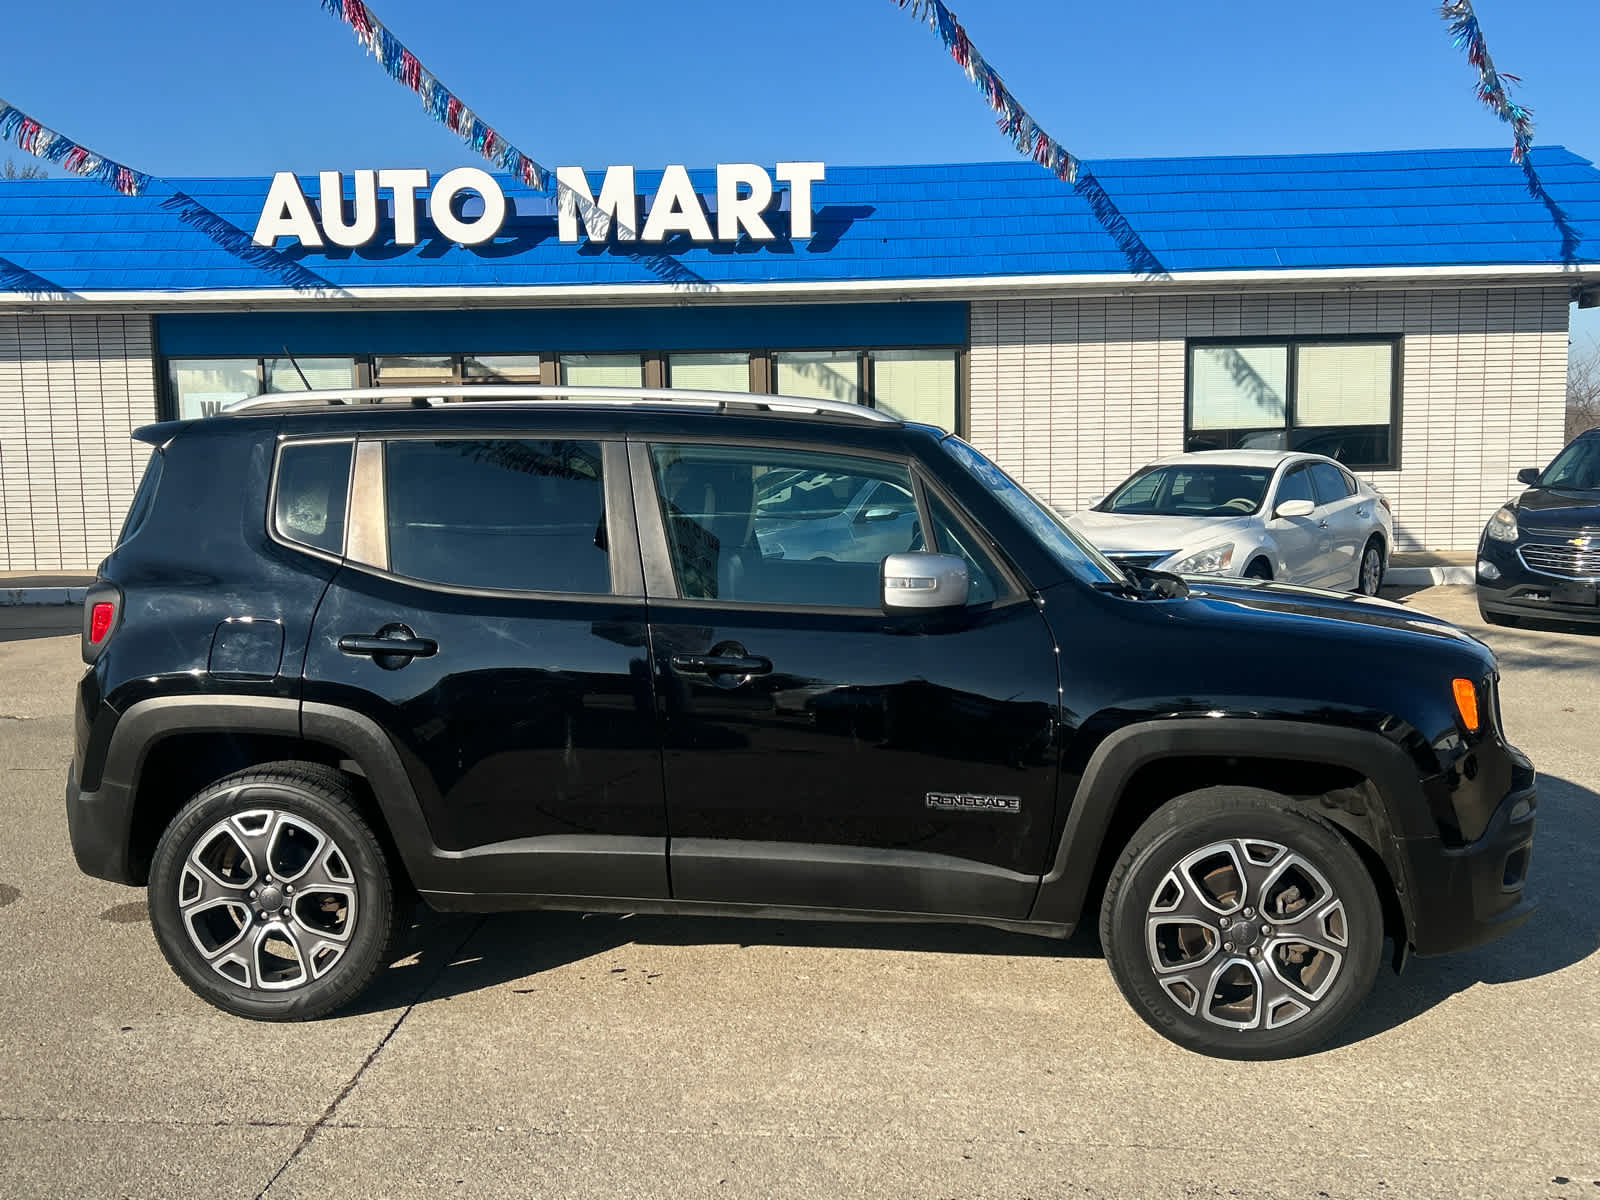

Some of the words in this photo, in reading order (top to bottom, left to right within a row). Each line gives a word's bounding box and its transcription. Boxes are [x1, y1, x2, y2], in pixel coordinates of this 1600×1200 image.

[252, 167, 506, 248] AUTO
[556, 161, 825, 243] MART
[926, 793, 1020, 810] RENEGADE
